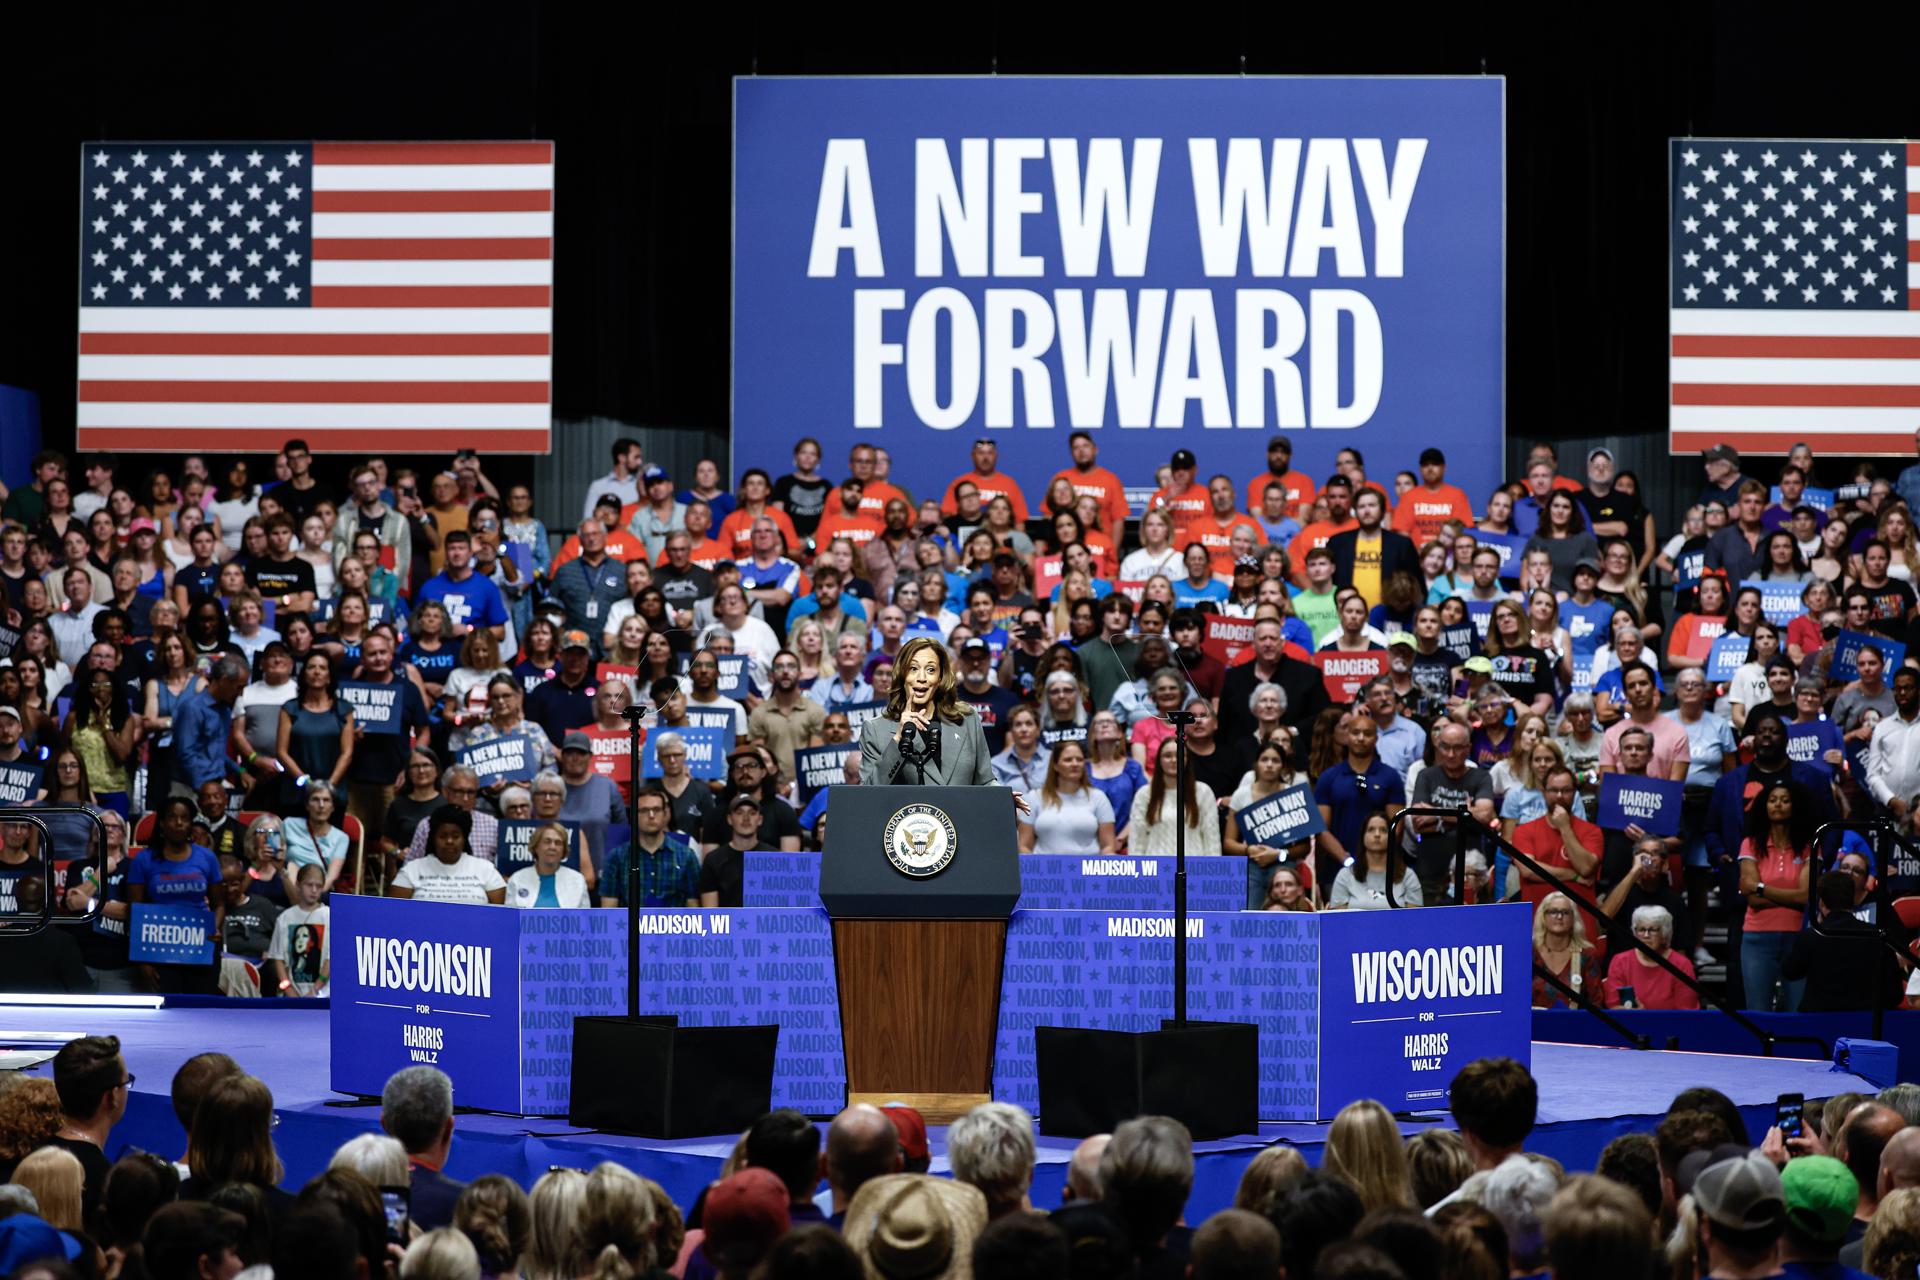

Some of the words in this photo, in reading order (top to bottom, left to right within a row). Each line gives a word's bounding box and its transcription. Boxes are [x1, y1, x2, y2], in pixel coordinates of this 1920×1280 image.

[807, 138, 885, 278] A
[915, 138, 1163, 278] NEW
[1188, 138, 1429, 278] WAY
[853, 287, 1384, 431] FORWARD
[1761, 595, 1801, 612] EEDOM
[1210, 622, 1255, 641] BADGER
[1324, 659, 1380, 676] BADGERS
[1718, 651, 1748, 668] FREE
[370, 689, 396, 707] WAY
[353, 706, 391, 722] WARD
[703, 713, 730, 730] WAY
[463, 753, 473, 766] A
[473, 745, 499, 763] NEW
[499, 740, 525, 757] WAY
[592, 738, 631, 755] DGERS
[1785, 735, 1819, 754] ARRIS
[801, 755, 810, 771] A
[811, 752, 837, 770] NEW
[806, 769, 846, 787] FORWA
[1618, 789, 1663, 810] HARRIS
[918, 806, 933, 814] THE
[1244, 814, 1256, 830] A
[1254, 801, 1280, 824] NEW
[1278, 790, 1307, 811] WAY
[1624, 806, 1654, 819] WALZ
[505, 826, 518, 843] A
[886, 811, 905, 853] PRESIDENT
[934, 811, 955, 840] UNITED
[1255, 808, 1310, 843] FORWARD
[932, 844, 955, 871] STATES
[1893, 844, 1902, 859] A
[797, 857, 811, 872] WI
[892, 855, 909, 872] VICE
[1047, 860, 1062, 875] WI
[1082, 860, 1139, 878] MADISON,
[1142, 860, 1158, 876] WI
[1186, 861, 1241, 878] ADISON,
[762, 876, 817, 892] MADISON,
[1023, 880, 1068, 896] ADISON,
[1071, 880, 1086, 894] WI
[1107, 880, 1163, 896] MADISON,
[1202, 880, 1246, 895] MADISO
[141, 923, 205, 946] FREEDOM
[589, 916, 608, 934] WI
[639, 914, 707, 937] MADISON,
[710, 914, 730, 934] WI
[756, 914, 829, 936] MADISON,
[1063, 918, 1082, 937] WI
[1108, 917, 1175, 938] MADISON
[1185, 918, 1204, 938] WI
[1230, 920, 1299, 941] MADISON,
[545, 940, 618, 960] MADISON,
[666, 939, 738, 960] MADISON,
[743, 939, 761, 957] WI
[788, 939, 832, 957] MADIS
[1017, 941, 1089, 963] MADISON,
[1094, 941, 1113, 960] WI
[1216, 943, 1235, 962] WI
[1261, 944, 1318, 963] MADISO
[355, 935, 492, 998] WISCONSIN
[589, 964, 608, 981] WI
[711, 963, 730, 981] WI
[756, 963, 829, 984] MADISON,
[1352, 944, 1503, 1004] WISCONSIN
[1063, 965, 1081, 984] WI
[1108, 966, 1175, 985] MADISON
[1230, 967, 1299, 990] MADISON,
[545, 987, 617, 1008] MADISON,
[666, 987, 738, 1008] MADISON,
[743, 987, 761, 1005] WI
[788, 987, 835, 1005] MADIS
[1017, 989, 1089, 1010] MADISON,
[1093, 989, 1112, 1007] WI
[1215, 991, 1234, 1009] WI
[1261, 991, 1318, 1010] MADISO
[416, 1004, 430, 1014] FOR
[1419, 1012, 1435, 1022] FOR
[756, 1011, 829, 1032] MADISON,
[403, 1024, 443, 1051] HARRIS
[1404, 1033, 1449, 1058] HARRIS
[410, 1049, 438, 1064] WALZ
[1261, 1040, 1317, 1058] MADISO
[1411, 1058, 1441, 1072] WALZ
[1260, 1087, 1317, 1106] MADISO
